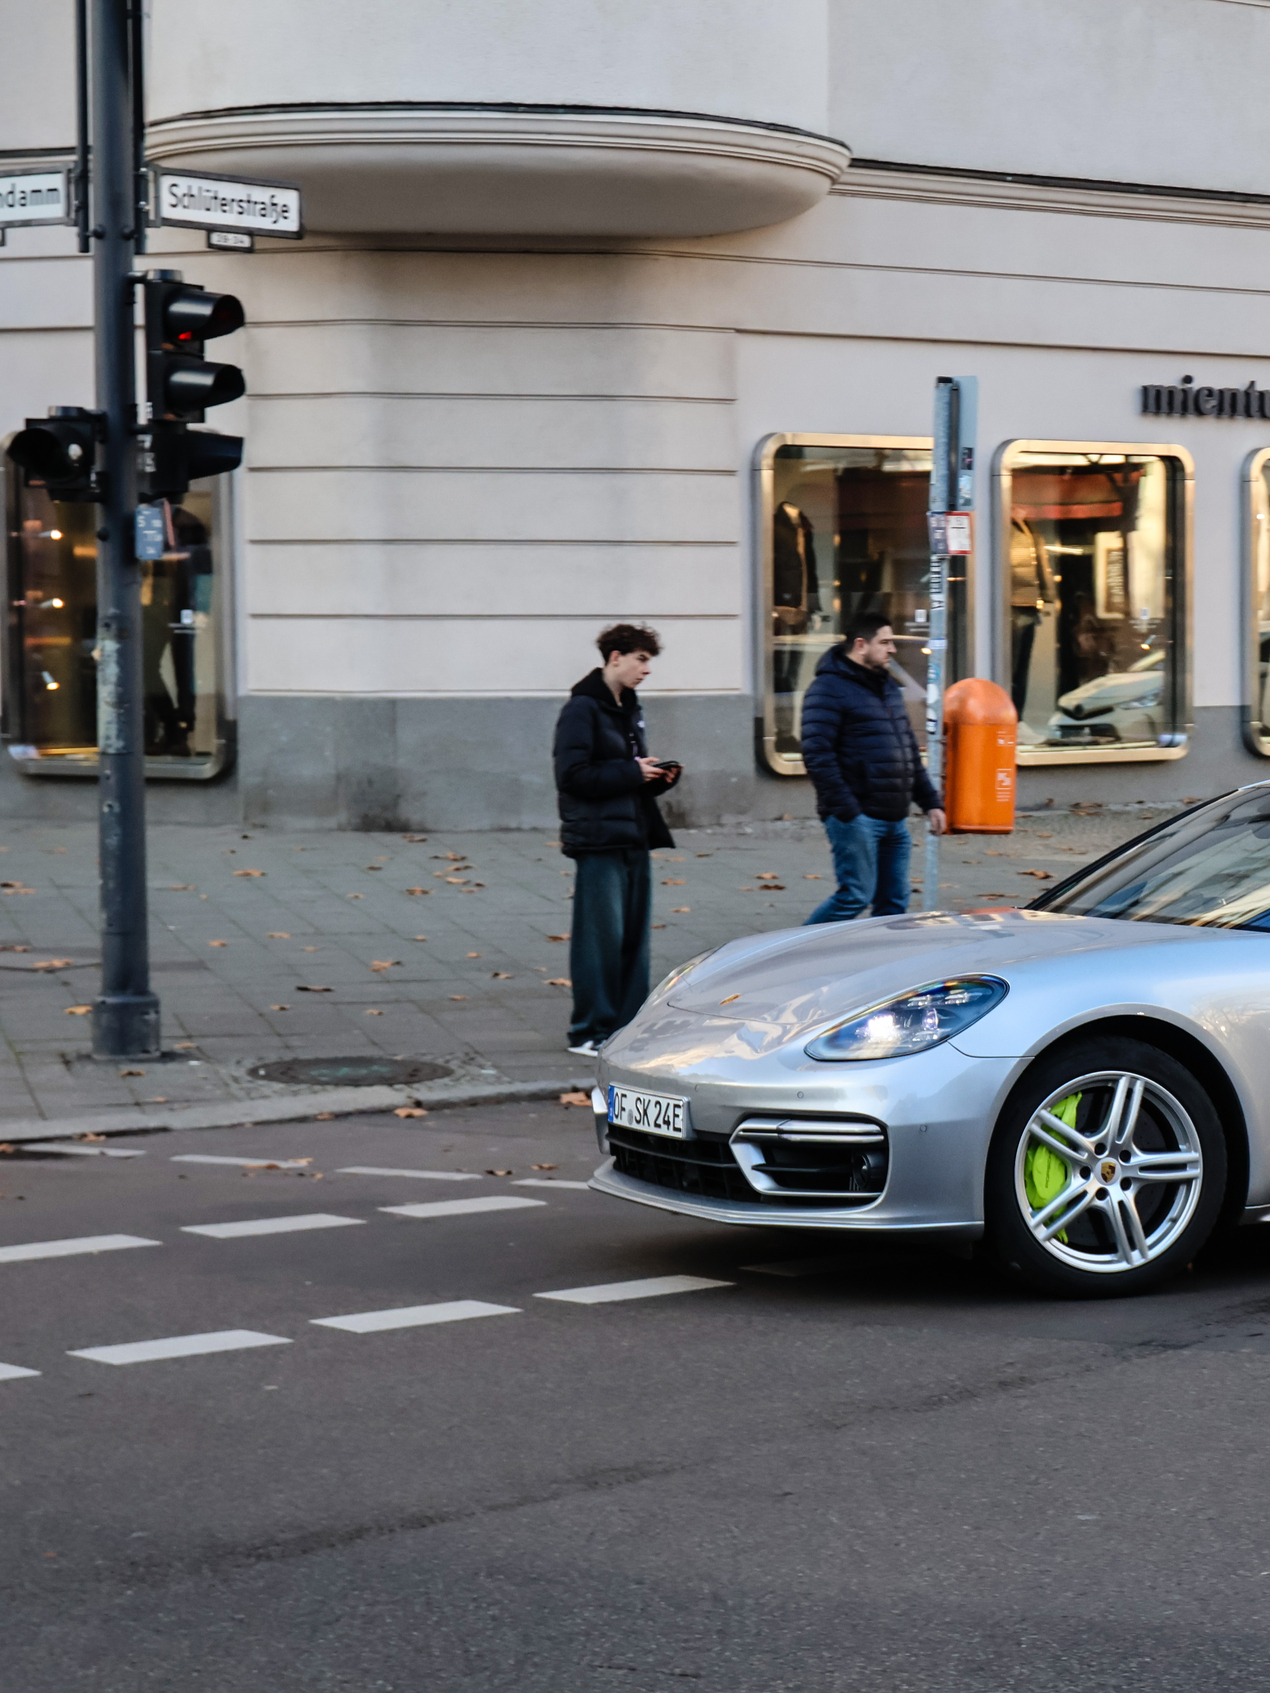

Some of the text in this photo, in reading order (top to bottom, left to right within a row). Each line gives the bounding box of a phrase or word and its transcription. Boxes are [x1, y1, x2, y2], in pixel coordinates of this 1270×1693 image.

[168, 183, 290, 224] Schlüterstraße
[613, 1091, 682, 1133] OF SK 24E
